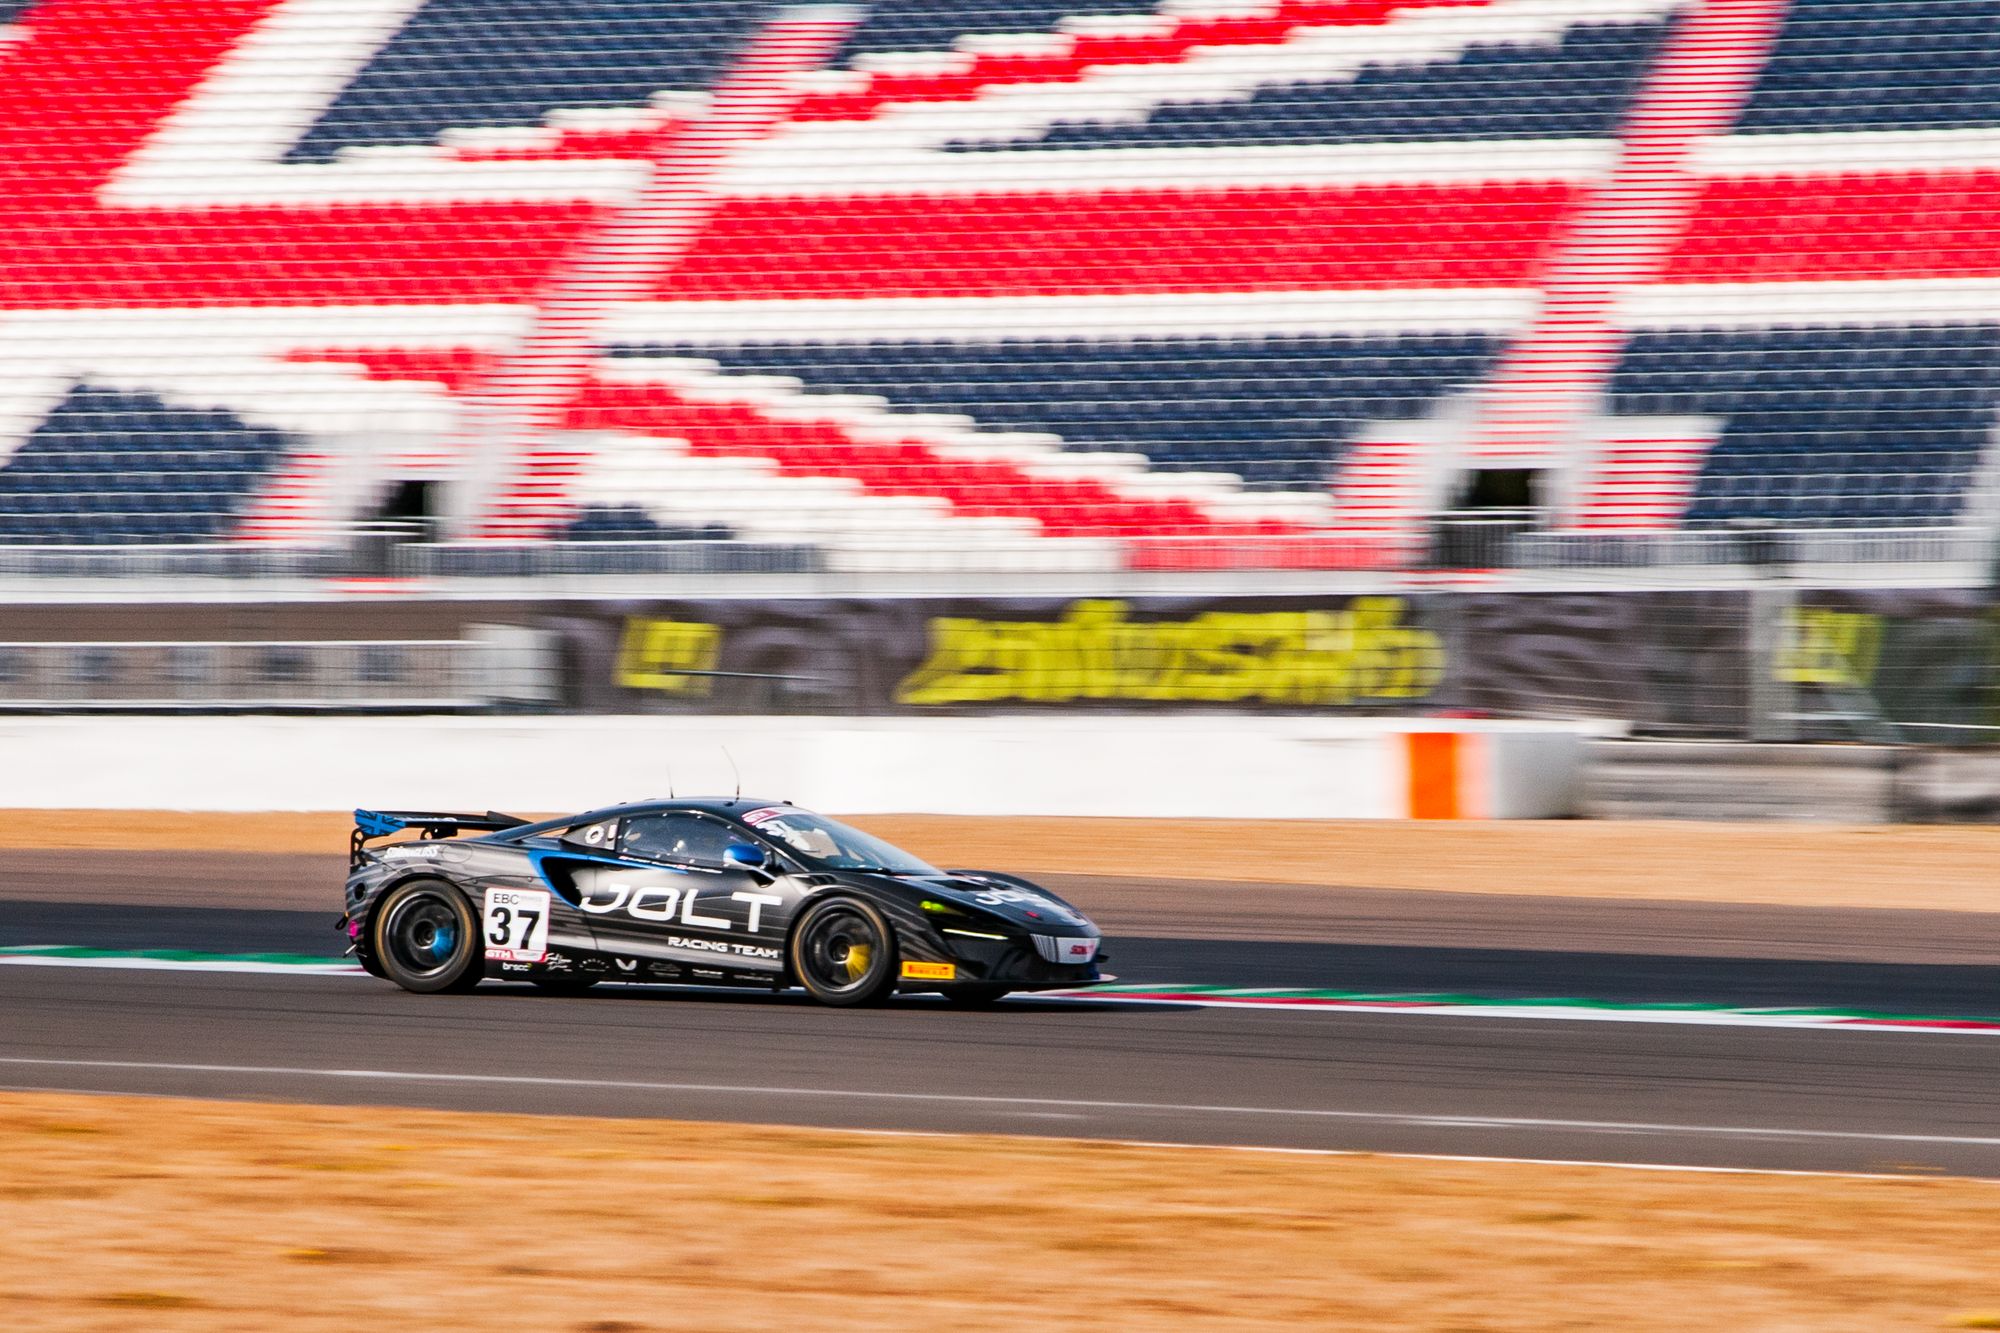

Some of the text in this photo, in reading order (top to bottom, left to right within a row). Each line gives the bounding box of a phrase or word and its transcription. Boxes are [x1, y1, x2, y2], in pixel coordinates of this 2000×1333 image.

[493, 893, 520, 905] EBC
[580, 884, 783, 933] JOLT
[489, 906, 540, 950] 37
[667, 936, 779, 959] RACING TEAM
